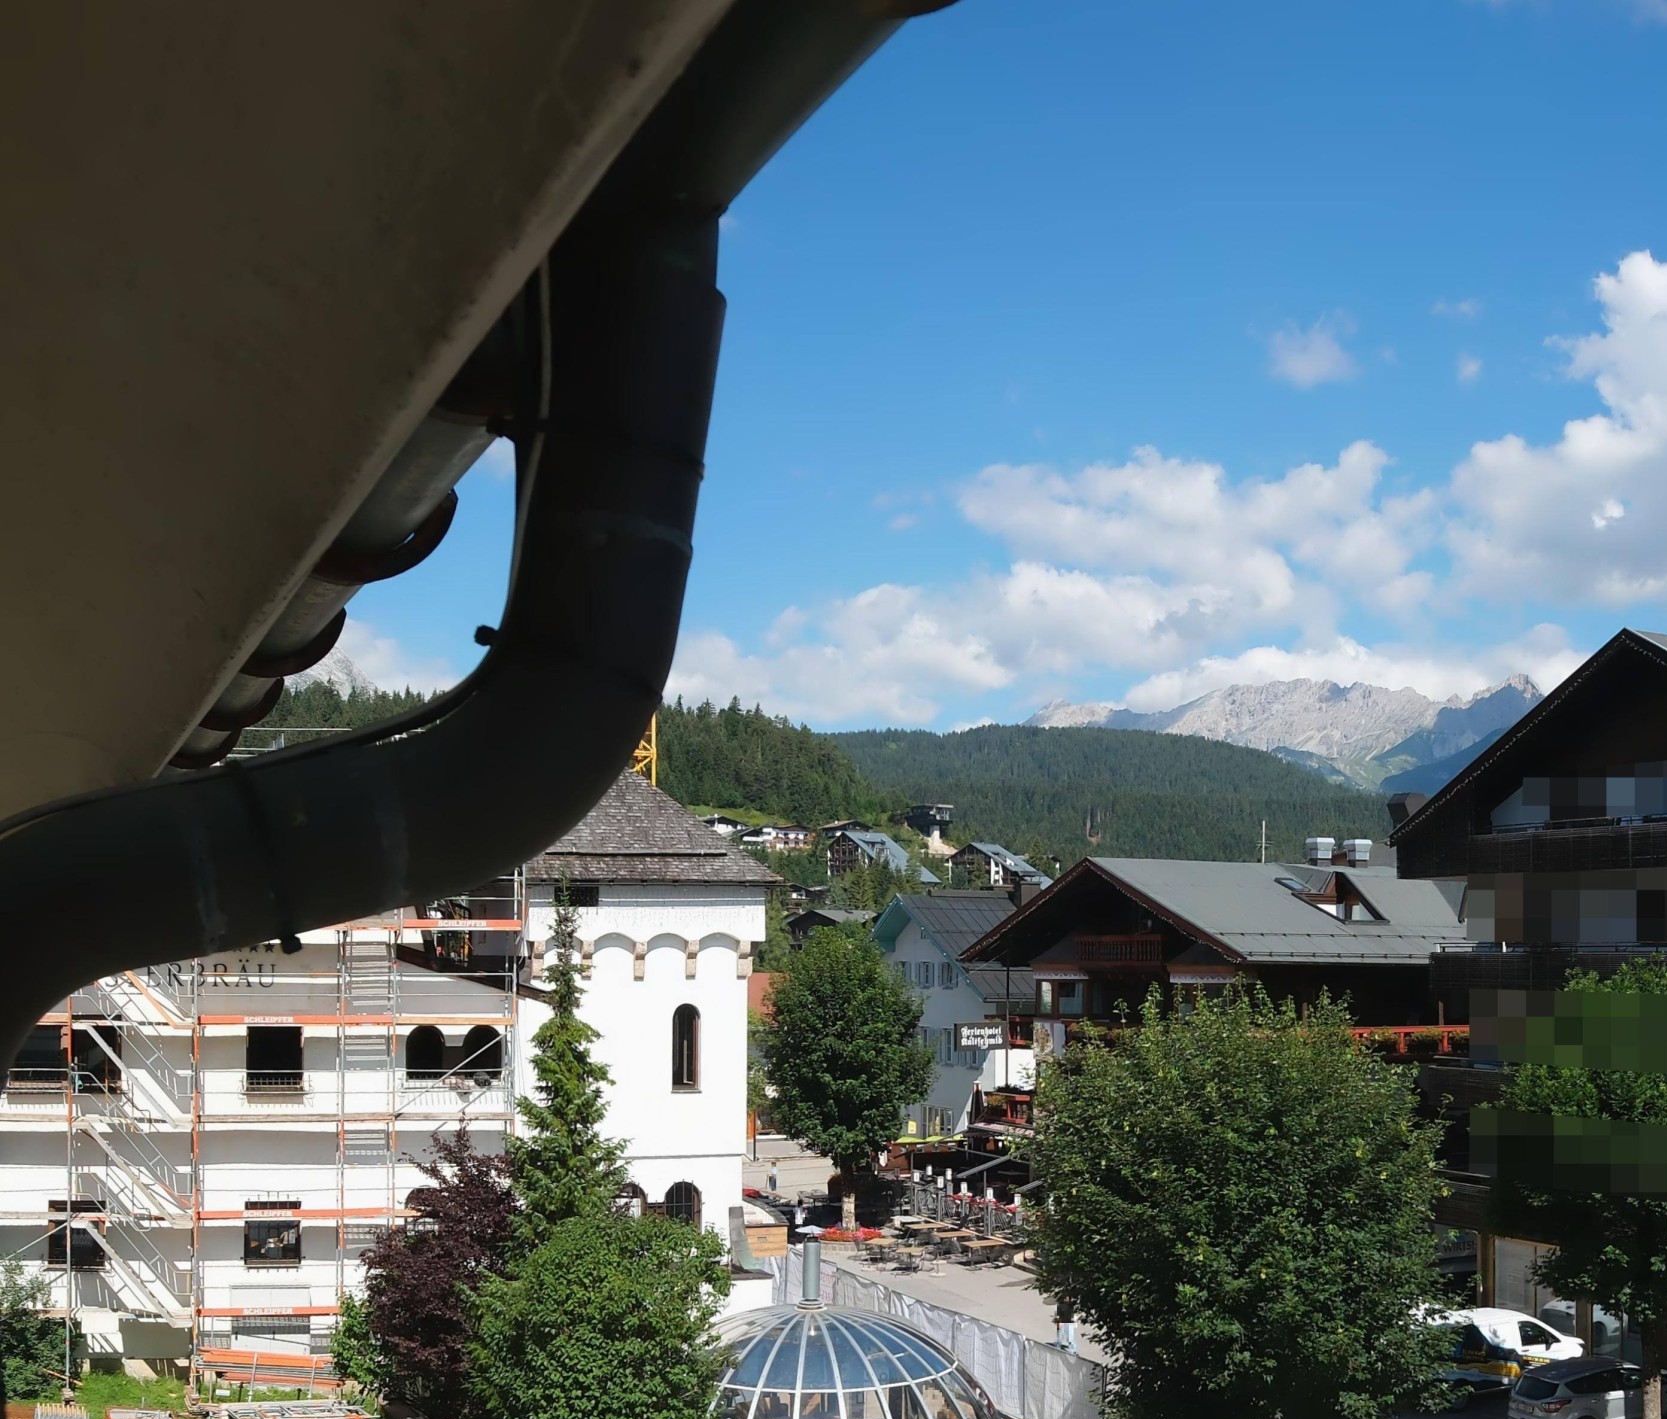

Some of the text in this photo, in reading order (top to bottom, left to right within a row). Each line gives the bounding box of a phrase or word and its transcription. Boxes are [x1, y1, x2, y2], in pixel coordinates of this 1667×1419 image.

[437, 919, 488, 928] SCHLEIPFER
[243, 1015, 294, 1024] SCHLEIPFER
[242, 1209, 293, 1218] SCHLEIPFER
[242, 1307, 293, 1316] SCHLEIPFER
